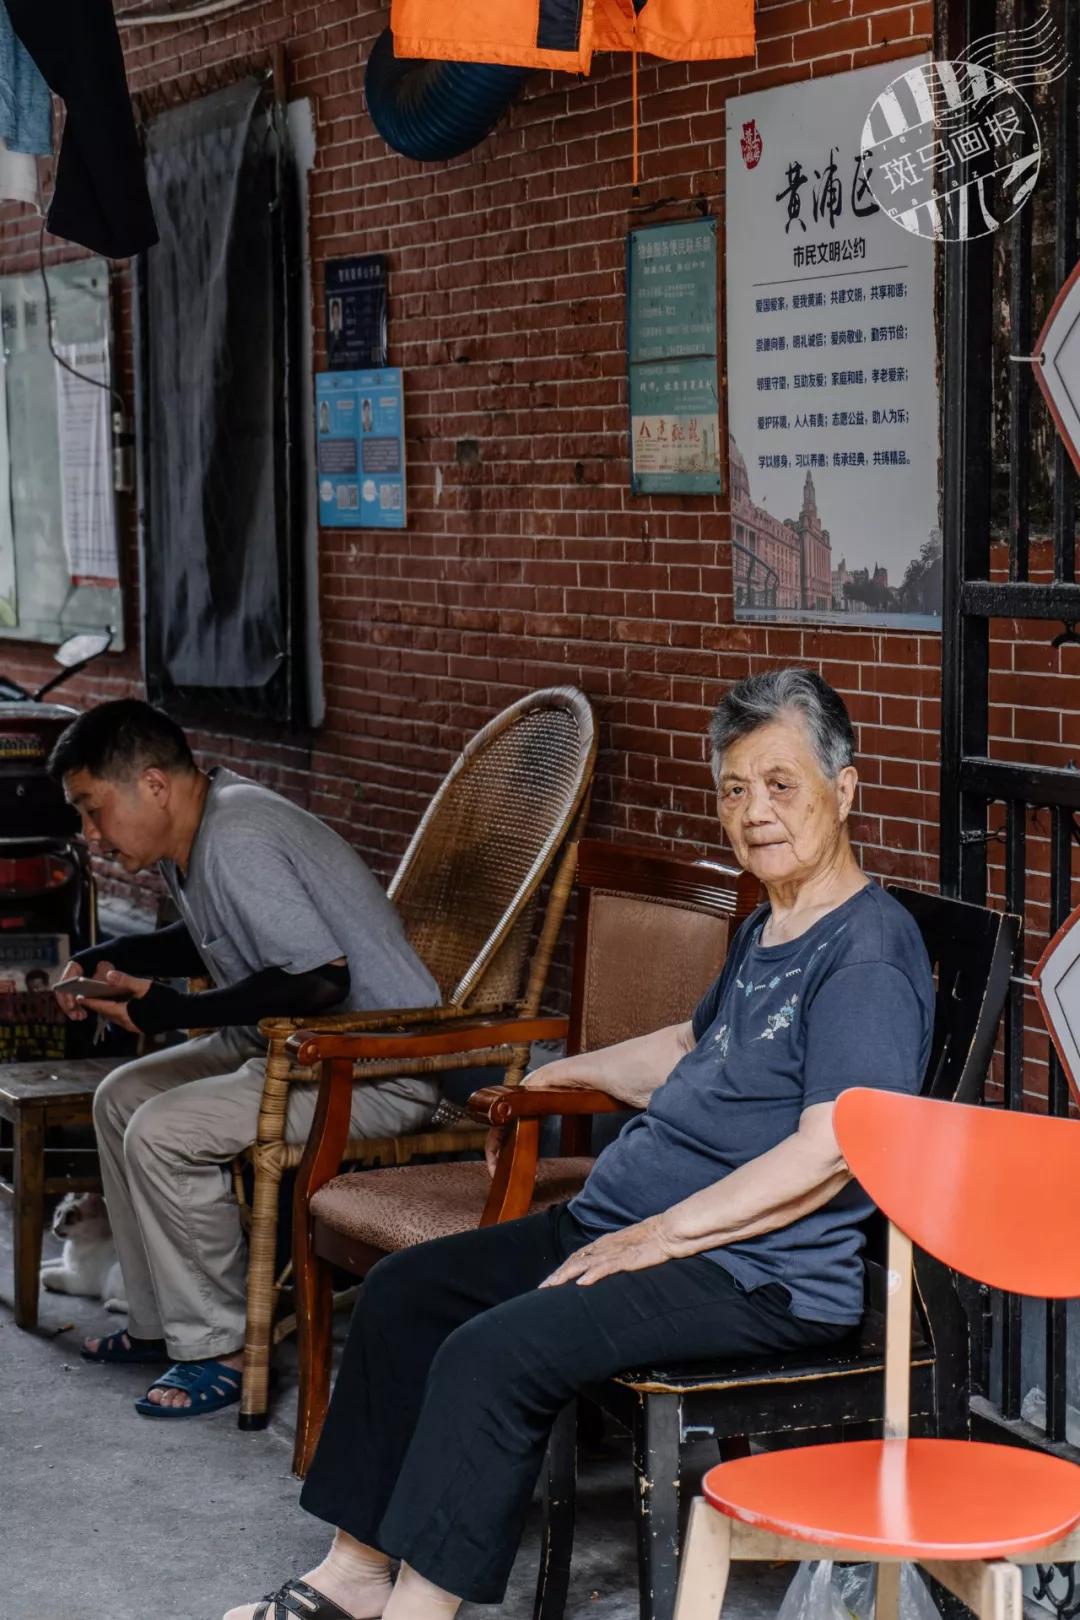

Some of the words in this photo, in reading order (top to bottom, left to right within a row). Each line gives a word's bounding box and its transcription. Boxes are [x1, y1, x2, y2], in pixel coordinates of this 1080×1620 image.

[776, 146, 880, 234] 黄浦区
[793, 237, 866, 268] 市民文明公约
